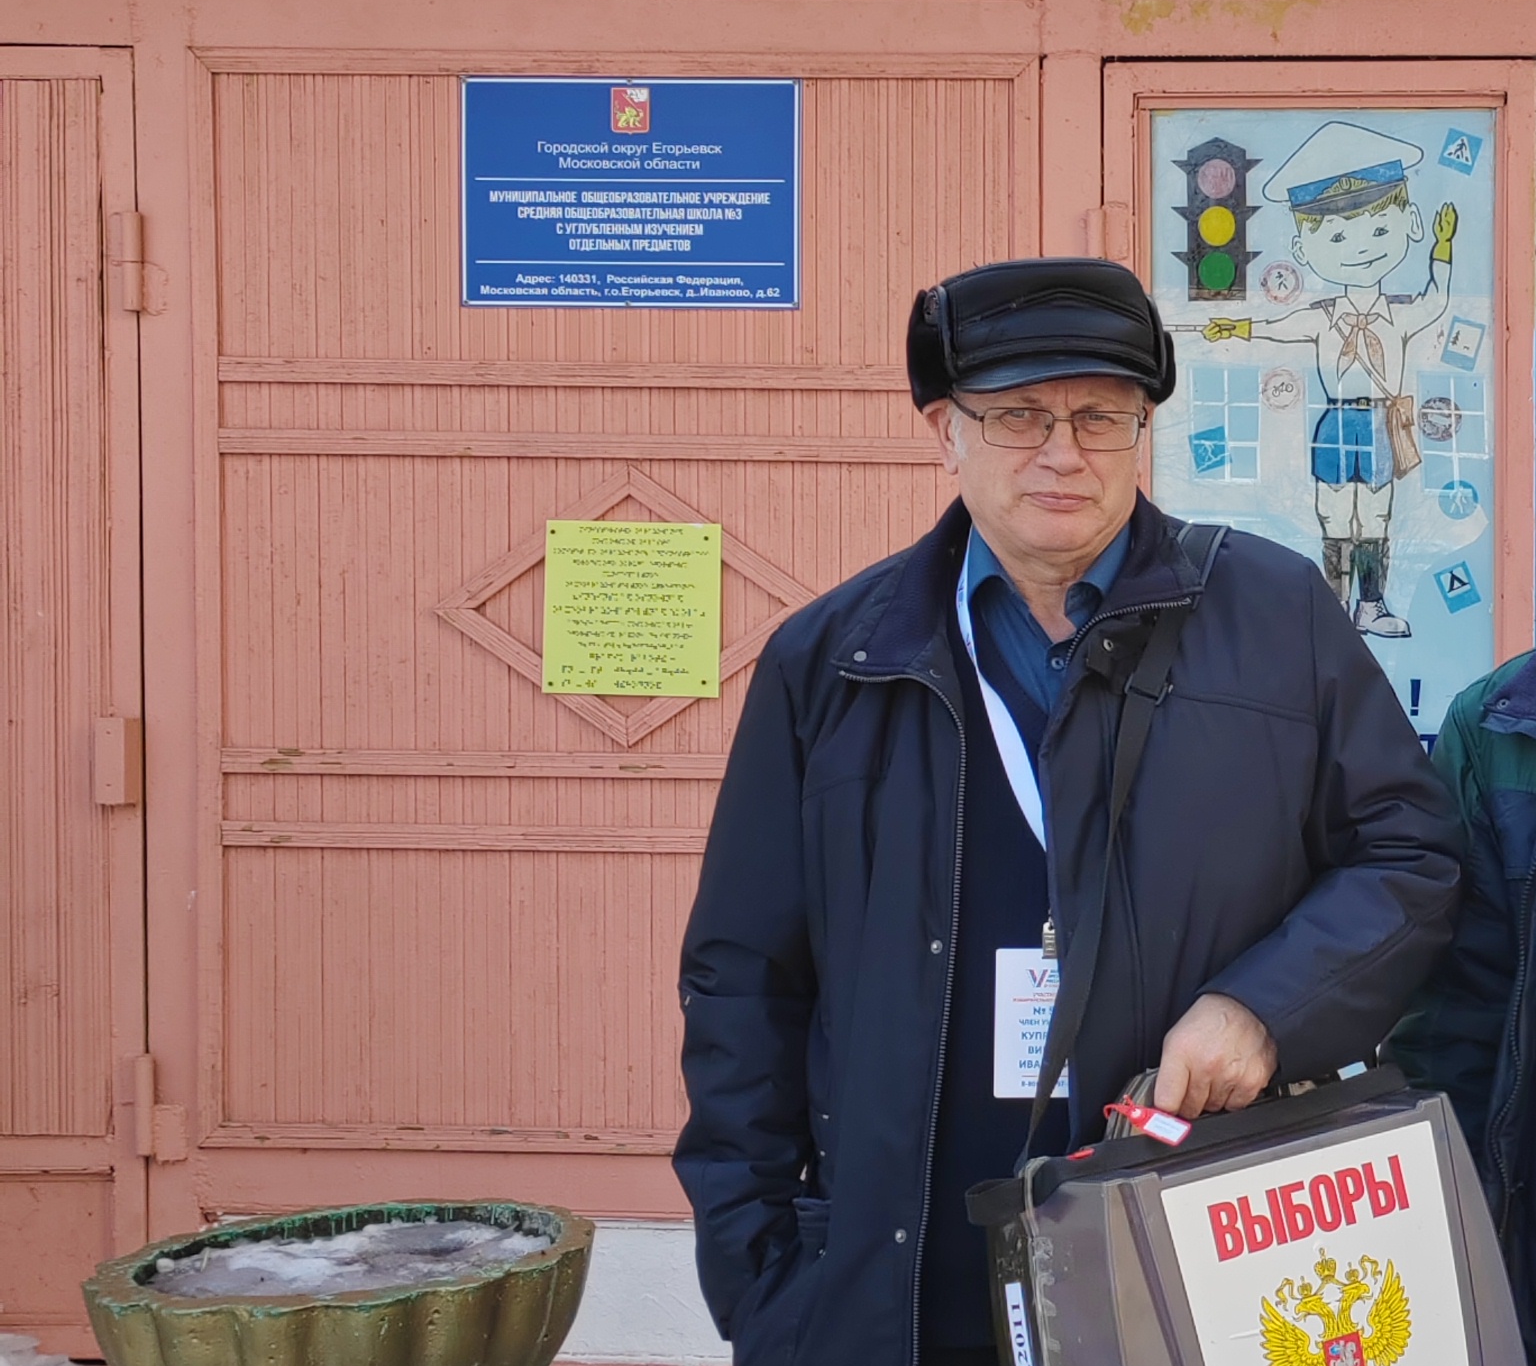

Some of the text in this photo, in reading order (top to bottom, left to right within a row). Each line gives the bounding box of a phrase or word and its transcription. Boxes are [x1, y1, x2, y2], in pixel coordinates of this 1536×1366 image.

[537, 140, 722, 156] Городской округ Егорьевск
[558, 157, 700, 170] Московской области
[489, 190, 771, 205] МУНИЦИПАЛЬНОЕ ОБЩЕОБРАЗОВАТЕЛЬНОЕ УЧРЕЖДЕНИЕ
[517, 206, 562, 219] СРЕДНЯЯ
[565, 207, 685, 220] ОБЩЕОБРАЗОВАТЕЛЬНАЯ
[687, 208, 723, 220] ШКОЛА
[565, 223, 643, 235] УГЛУБЛЕННЫМ
[644, 224, 704, 235] ИЗУЧЕНИЕМ
[569, 239, 691, 252] ОТДЕЛЬНЫХ ПРЕДМЕТОВ
[515, 273, 556, 285] Адрес:
[606, 274, 673, 284] Российская
[480, 285, 548, 296] Московская
[1207, 1154, 1410, 1262] ВЫБОРЫ
